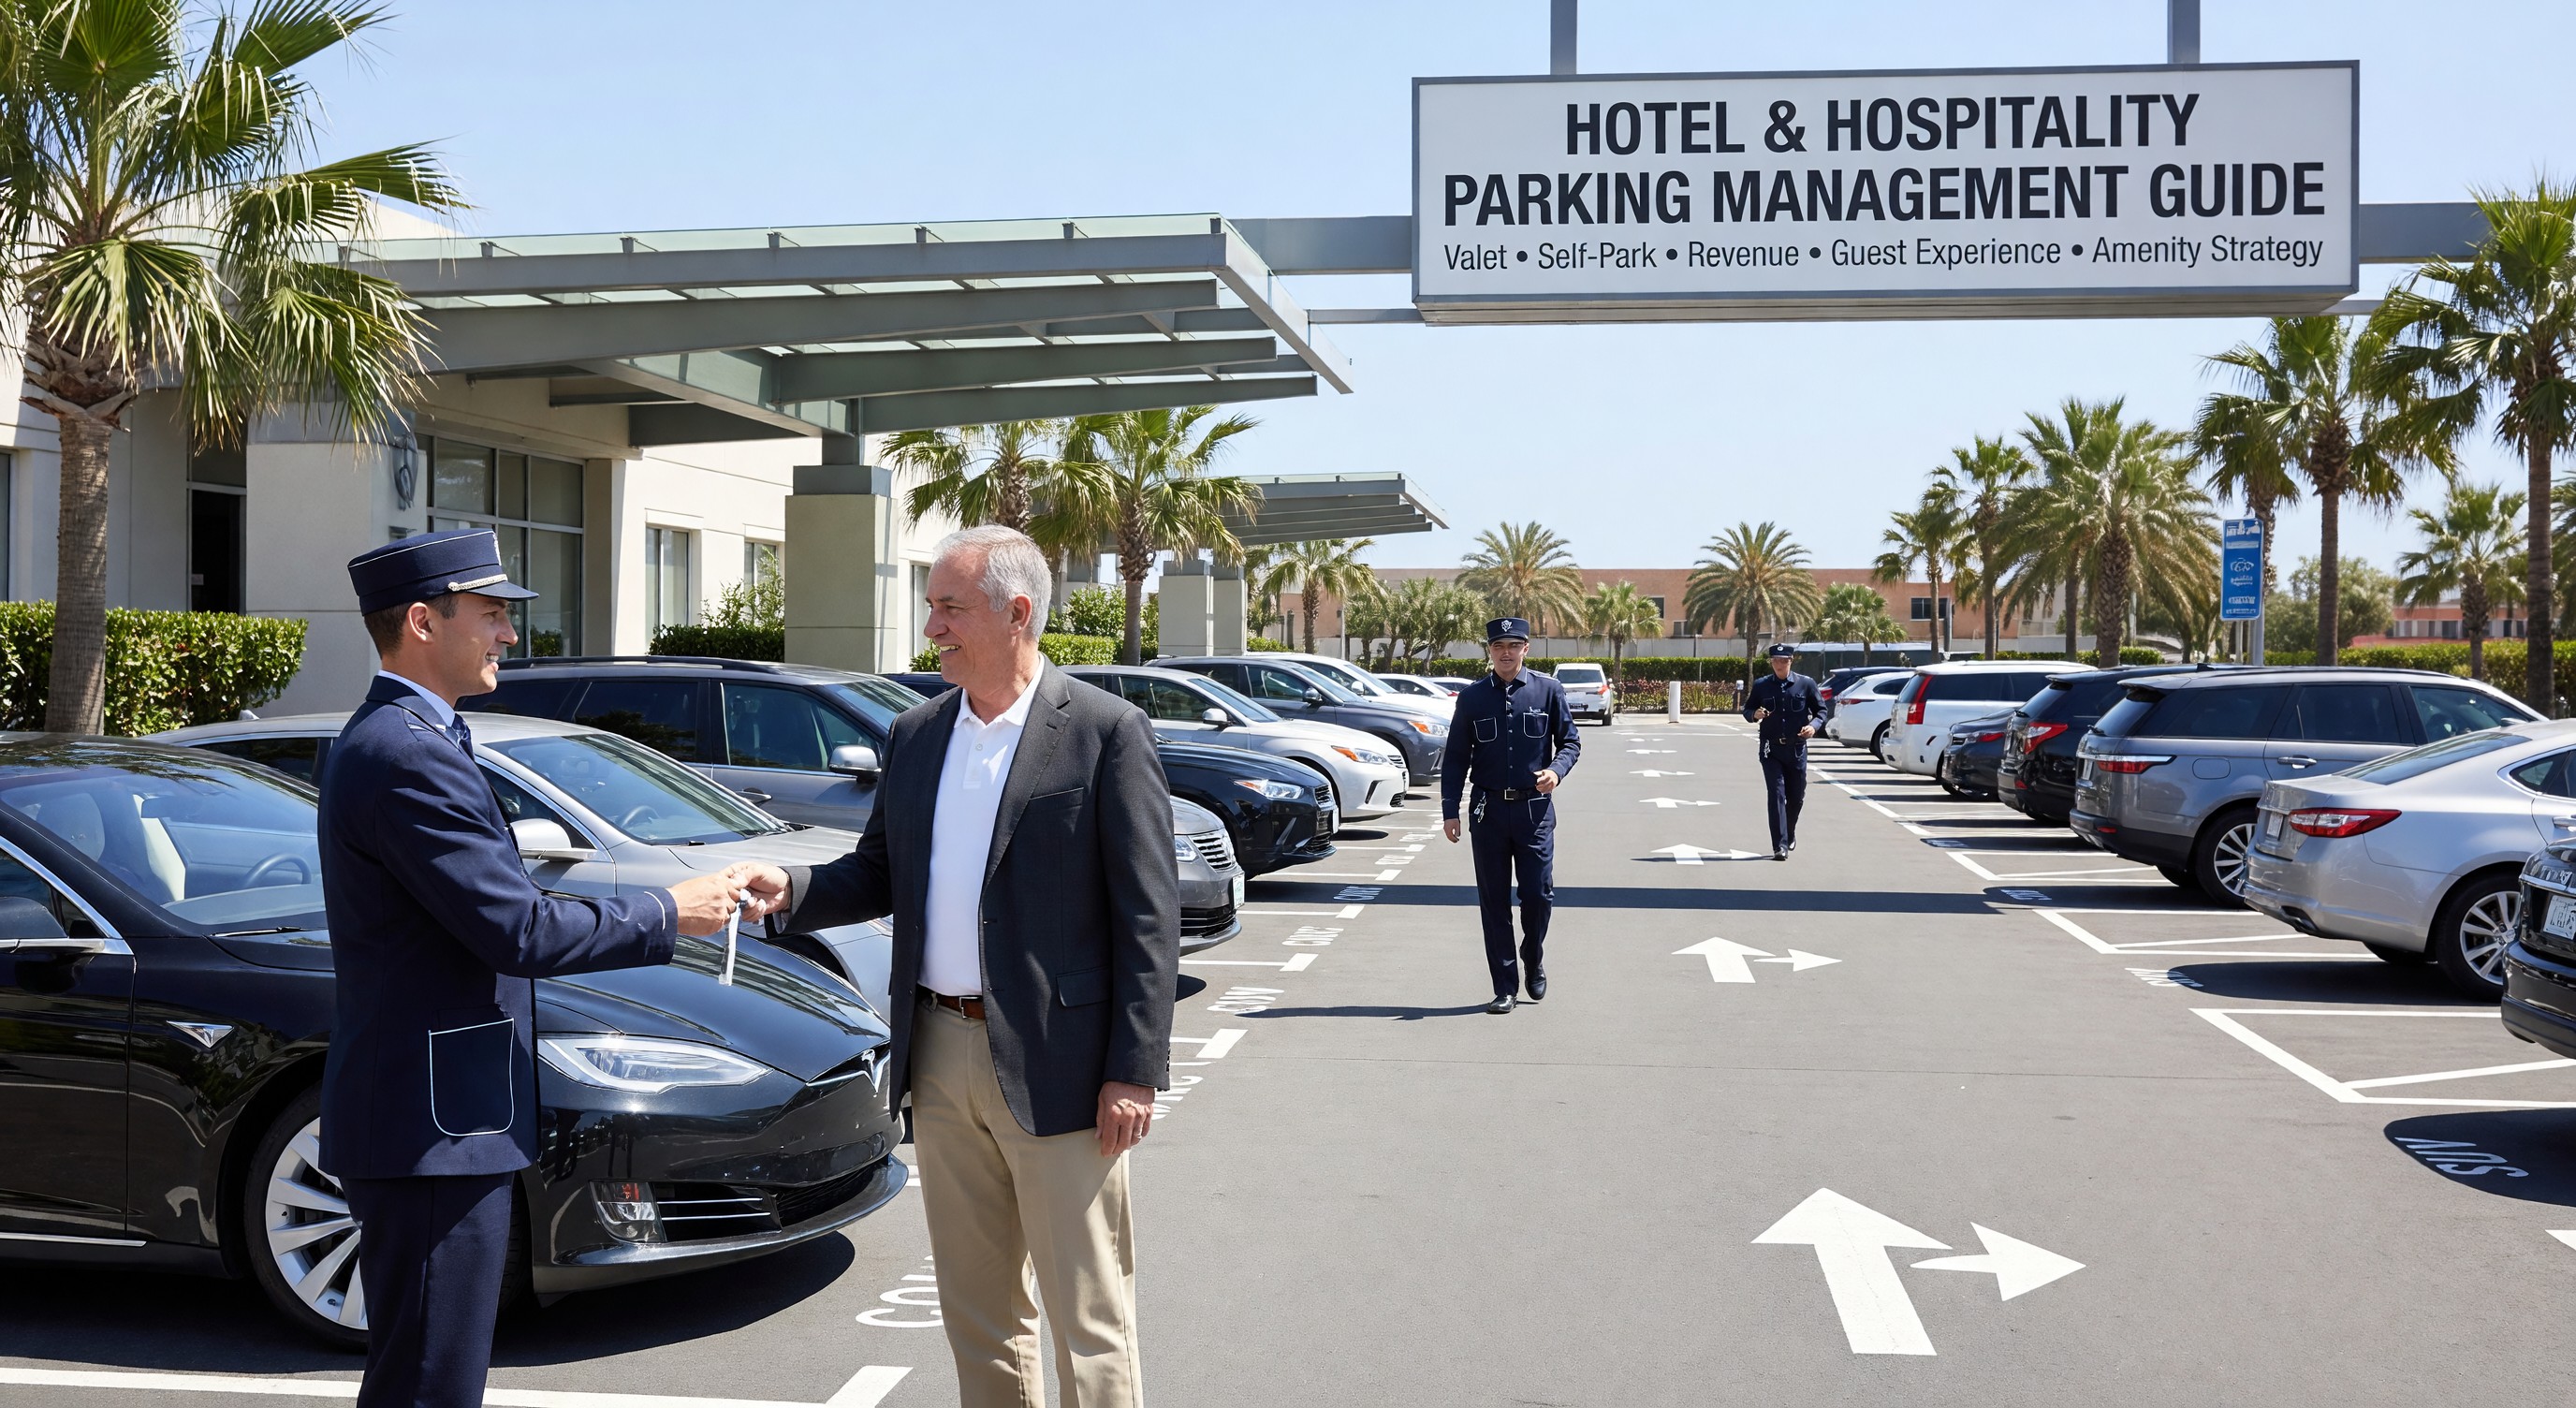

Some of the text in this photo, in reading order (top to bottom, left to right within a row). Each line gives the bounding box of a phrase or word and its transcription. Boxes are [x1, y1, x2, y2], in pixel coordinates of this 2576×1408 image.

[1566, 93, 2201, 155] HOTEL & HOSPITALITY
[1444, 161, 2325, 227] PARKING MANAGEMENT GUIDE
[1443, 243, 1508, 271] Valet
[1538, 242, 1658, 270] Self-Park
[1689, 241, 1799, 268] Revenue
[1831, 239, 1908, 266] Guest
[1916, 238, 2061, 271] Experience
[2091, 236, 2202, 269] Amenity
[2211, 234, 2324, 268] Strategy
[2394, 1137, 2529, 1178] SUV
